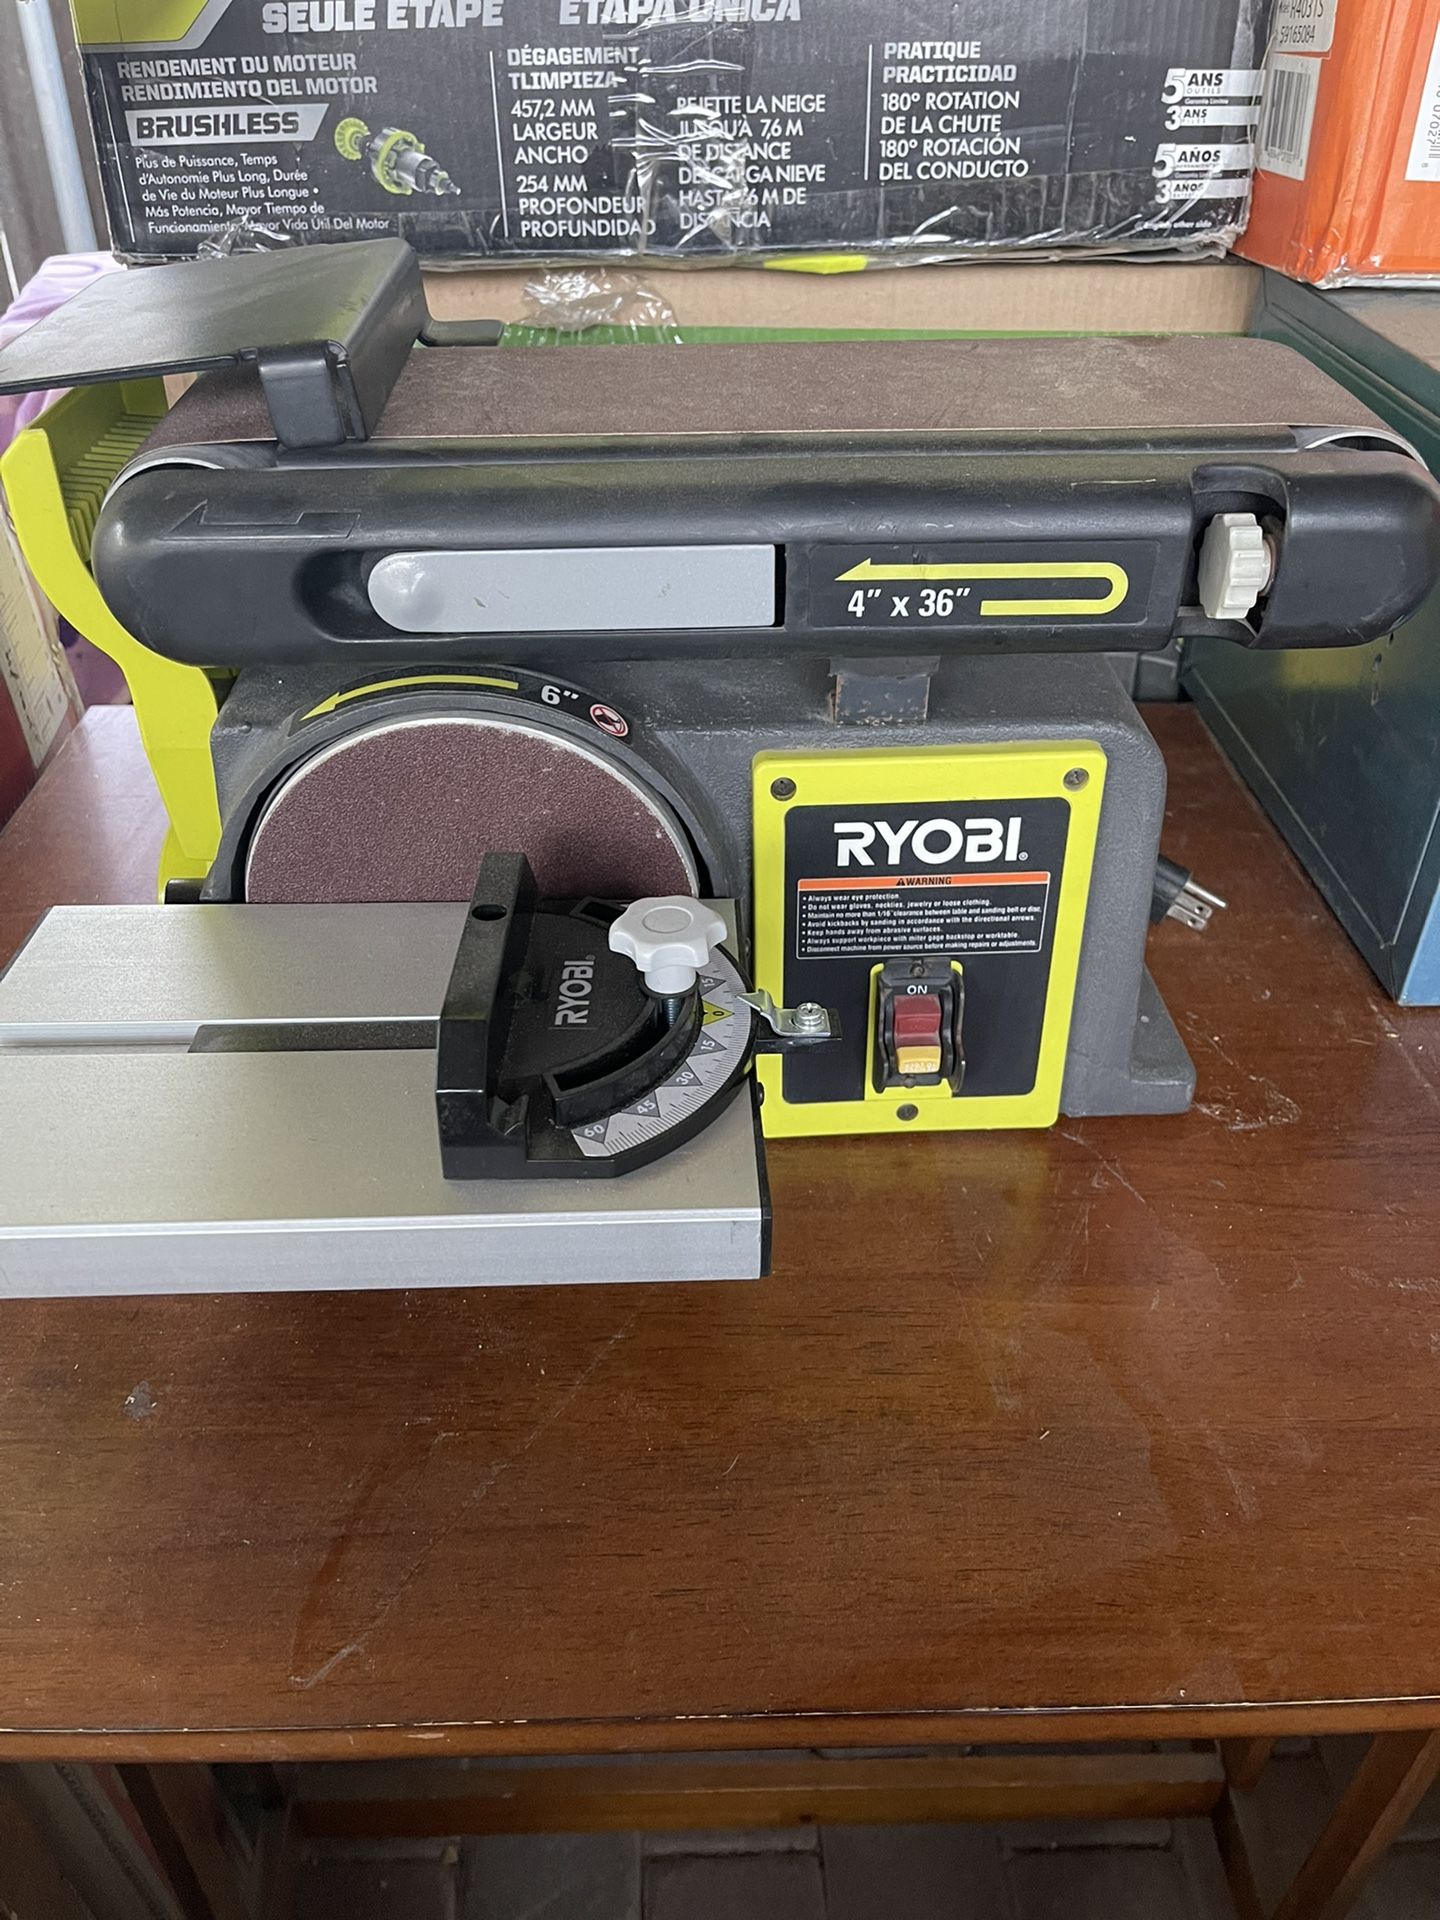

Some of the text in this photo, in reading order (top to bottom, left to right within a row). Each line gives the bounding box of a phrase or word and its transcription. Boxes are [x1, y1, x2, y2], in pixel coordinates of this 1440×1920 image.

[262, 0, 375, 33] SEULE
[559, 0, 676, 25] ETAPA
[507, 44, 639, 66] DÉGAGEMENT
[884, 41, 981, 62] PRATIQUE
[117, 53, 358, 79] RENDEMENT DU MOTEUR
[883, 64, 1017, 83] PRACTICIDAD
[121, 77, 378, 102] RENDIMIENTO DEL MOTOR
[508, 71, 618, 90] TLIMPIEZA
[1161, 68, 1223, 104] 5 ANS
[511, 99, 595, 120] 457,2 MM
[746, 94, 826, 114] LA NEIGE
[925, 91, 1020, 111] ROTATION
[136, 112, 300, 139] BRUSHLESS
[881, 114, 1002, 135] DE LA CHUTE
[1165, 105, 1207, 130] 3 ANS
[513, 122, 598, 141] LARGEUR
[760, 119, 804, 140] 7,6 M
[923, 132, 1021, 157] ROTACIÓN
[135, 153, 278, 169] Plus de Puissance, Temps
[514, 146, 588, 164] ANCHO
[1152, 143, 1221, 178] 5 AÑOS
[139, 169, 308, 185] d'Autonomie Plus Long, Durée
[776, 165, 826, 182] NIEVE
[879, 160, 1029, 180] DEL CONDUCTO
[142, 186, 309, 201] de Vie du Moteur Plus Longue
[517, 175, 588, 193] 254 MM
[1154, 179, 1172, 203] 3
[519, 196, 647, 215] PROFONDEUR
[762, 188, 779, 205] M
[783, 187, 806, 205] DE
[172, 203, 223, 217] Potencia,
[226, 204, 261, 216] Mayor
[264, 202, 307, 216] Tiempo
[310, 201, 325, 214] de
[282, 218, 308, 230] Vida
[333, 217, 353, 230] Del
[356, 218, 389, 230] Motor
[521, 219, 656, 238] PROFUNDIDAD
[847, 587, 971, 617] 4" x 36"
[541, 685, 579, 705] 6"
[834, 817, 1022, 867] RYOBI
[906, 876, 952, 886] WARNING
[907, 901, 932, 909] jewelry
[702, 977, 714, 988] 15
[907, 985, 927, 995] ON
[554, 960, 595, 1025] RYOBI
[701, 1039, 715, 1051] 15
[675, 1072, 694, 1086] 30
[636, 1101, 655, 1114] 45
[584, 1124, 604, 1138] 60
